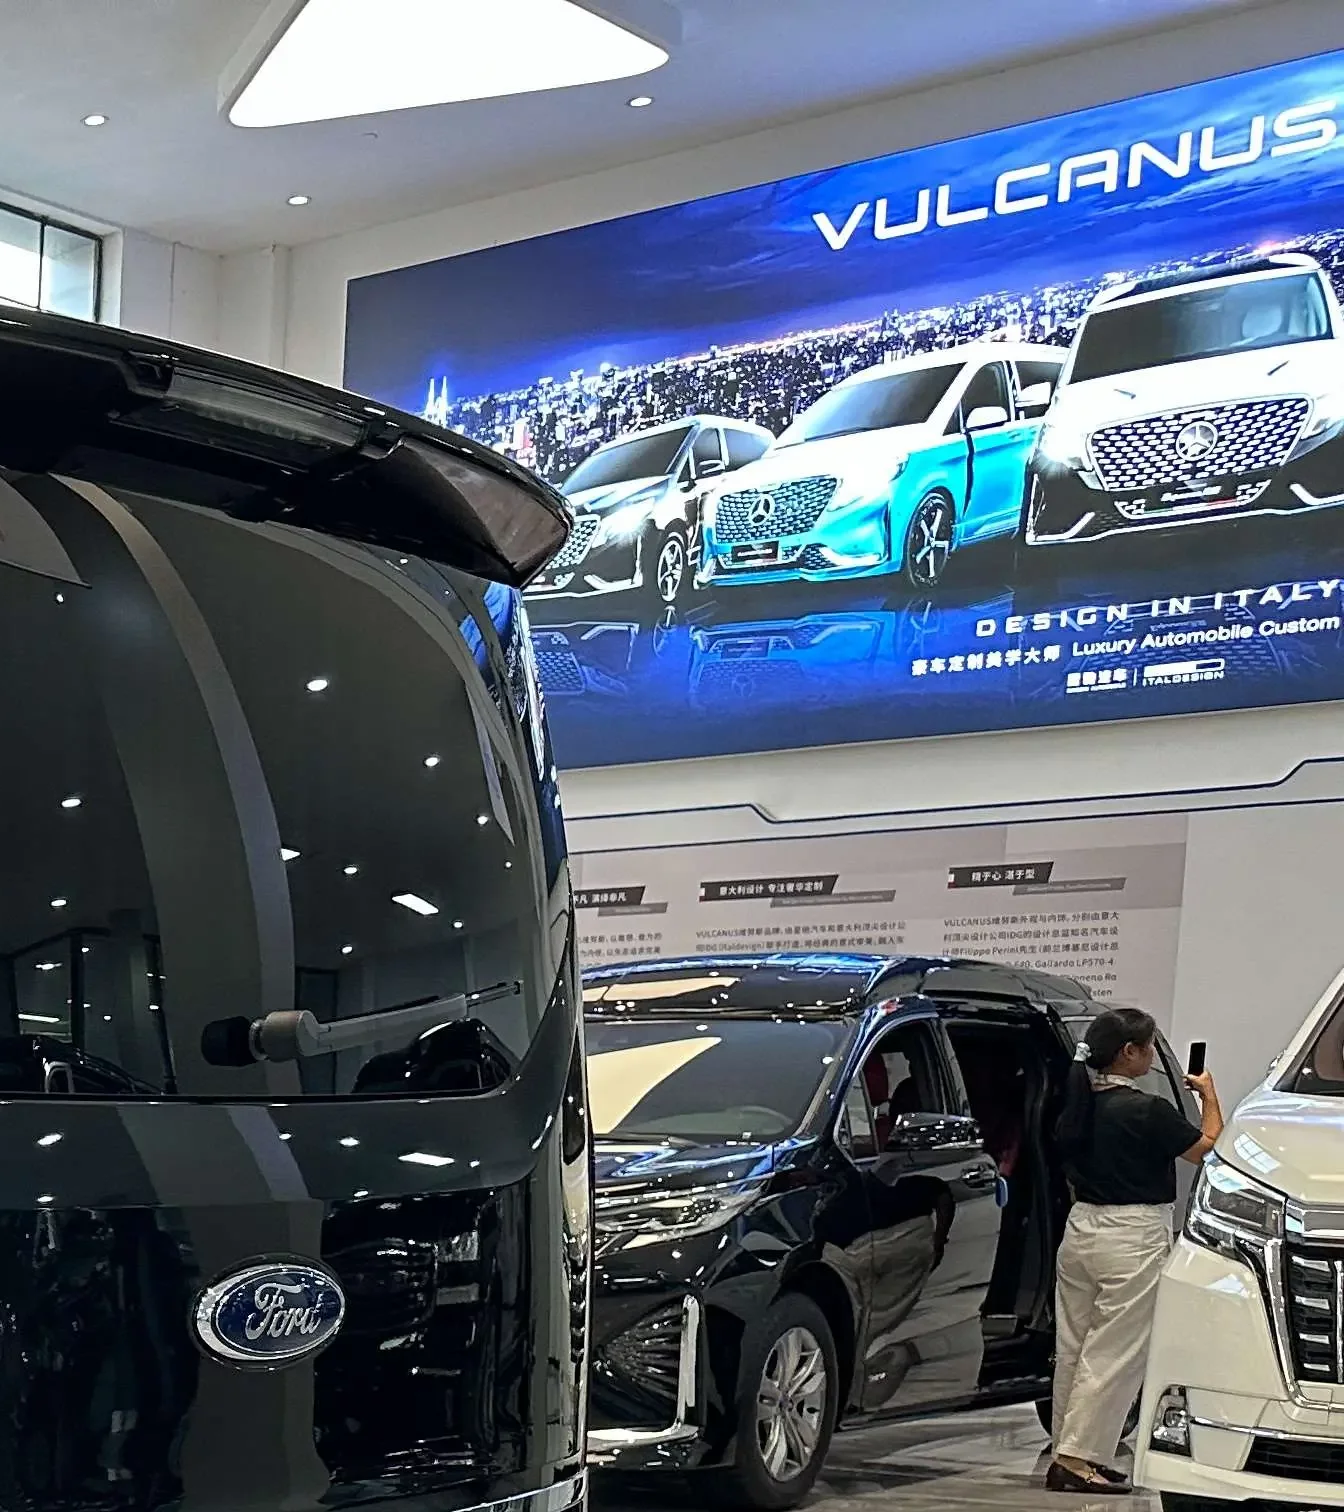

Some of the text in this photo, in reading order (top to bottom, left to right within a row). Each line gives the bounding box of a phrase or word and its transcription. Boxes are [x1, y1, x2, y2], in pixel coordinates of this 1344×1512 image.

[812, 100, 1338, 251] VULCANUS
[975, 577, 1341, 638] DESIGN IN ITALY
[1071, 615, 1341, 658] Luxury Automobile Custom
[1142, 669, 1225, 688] ITALDESIGN
[244, 1282, 325, 1341] Ford
